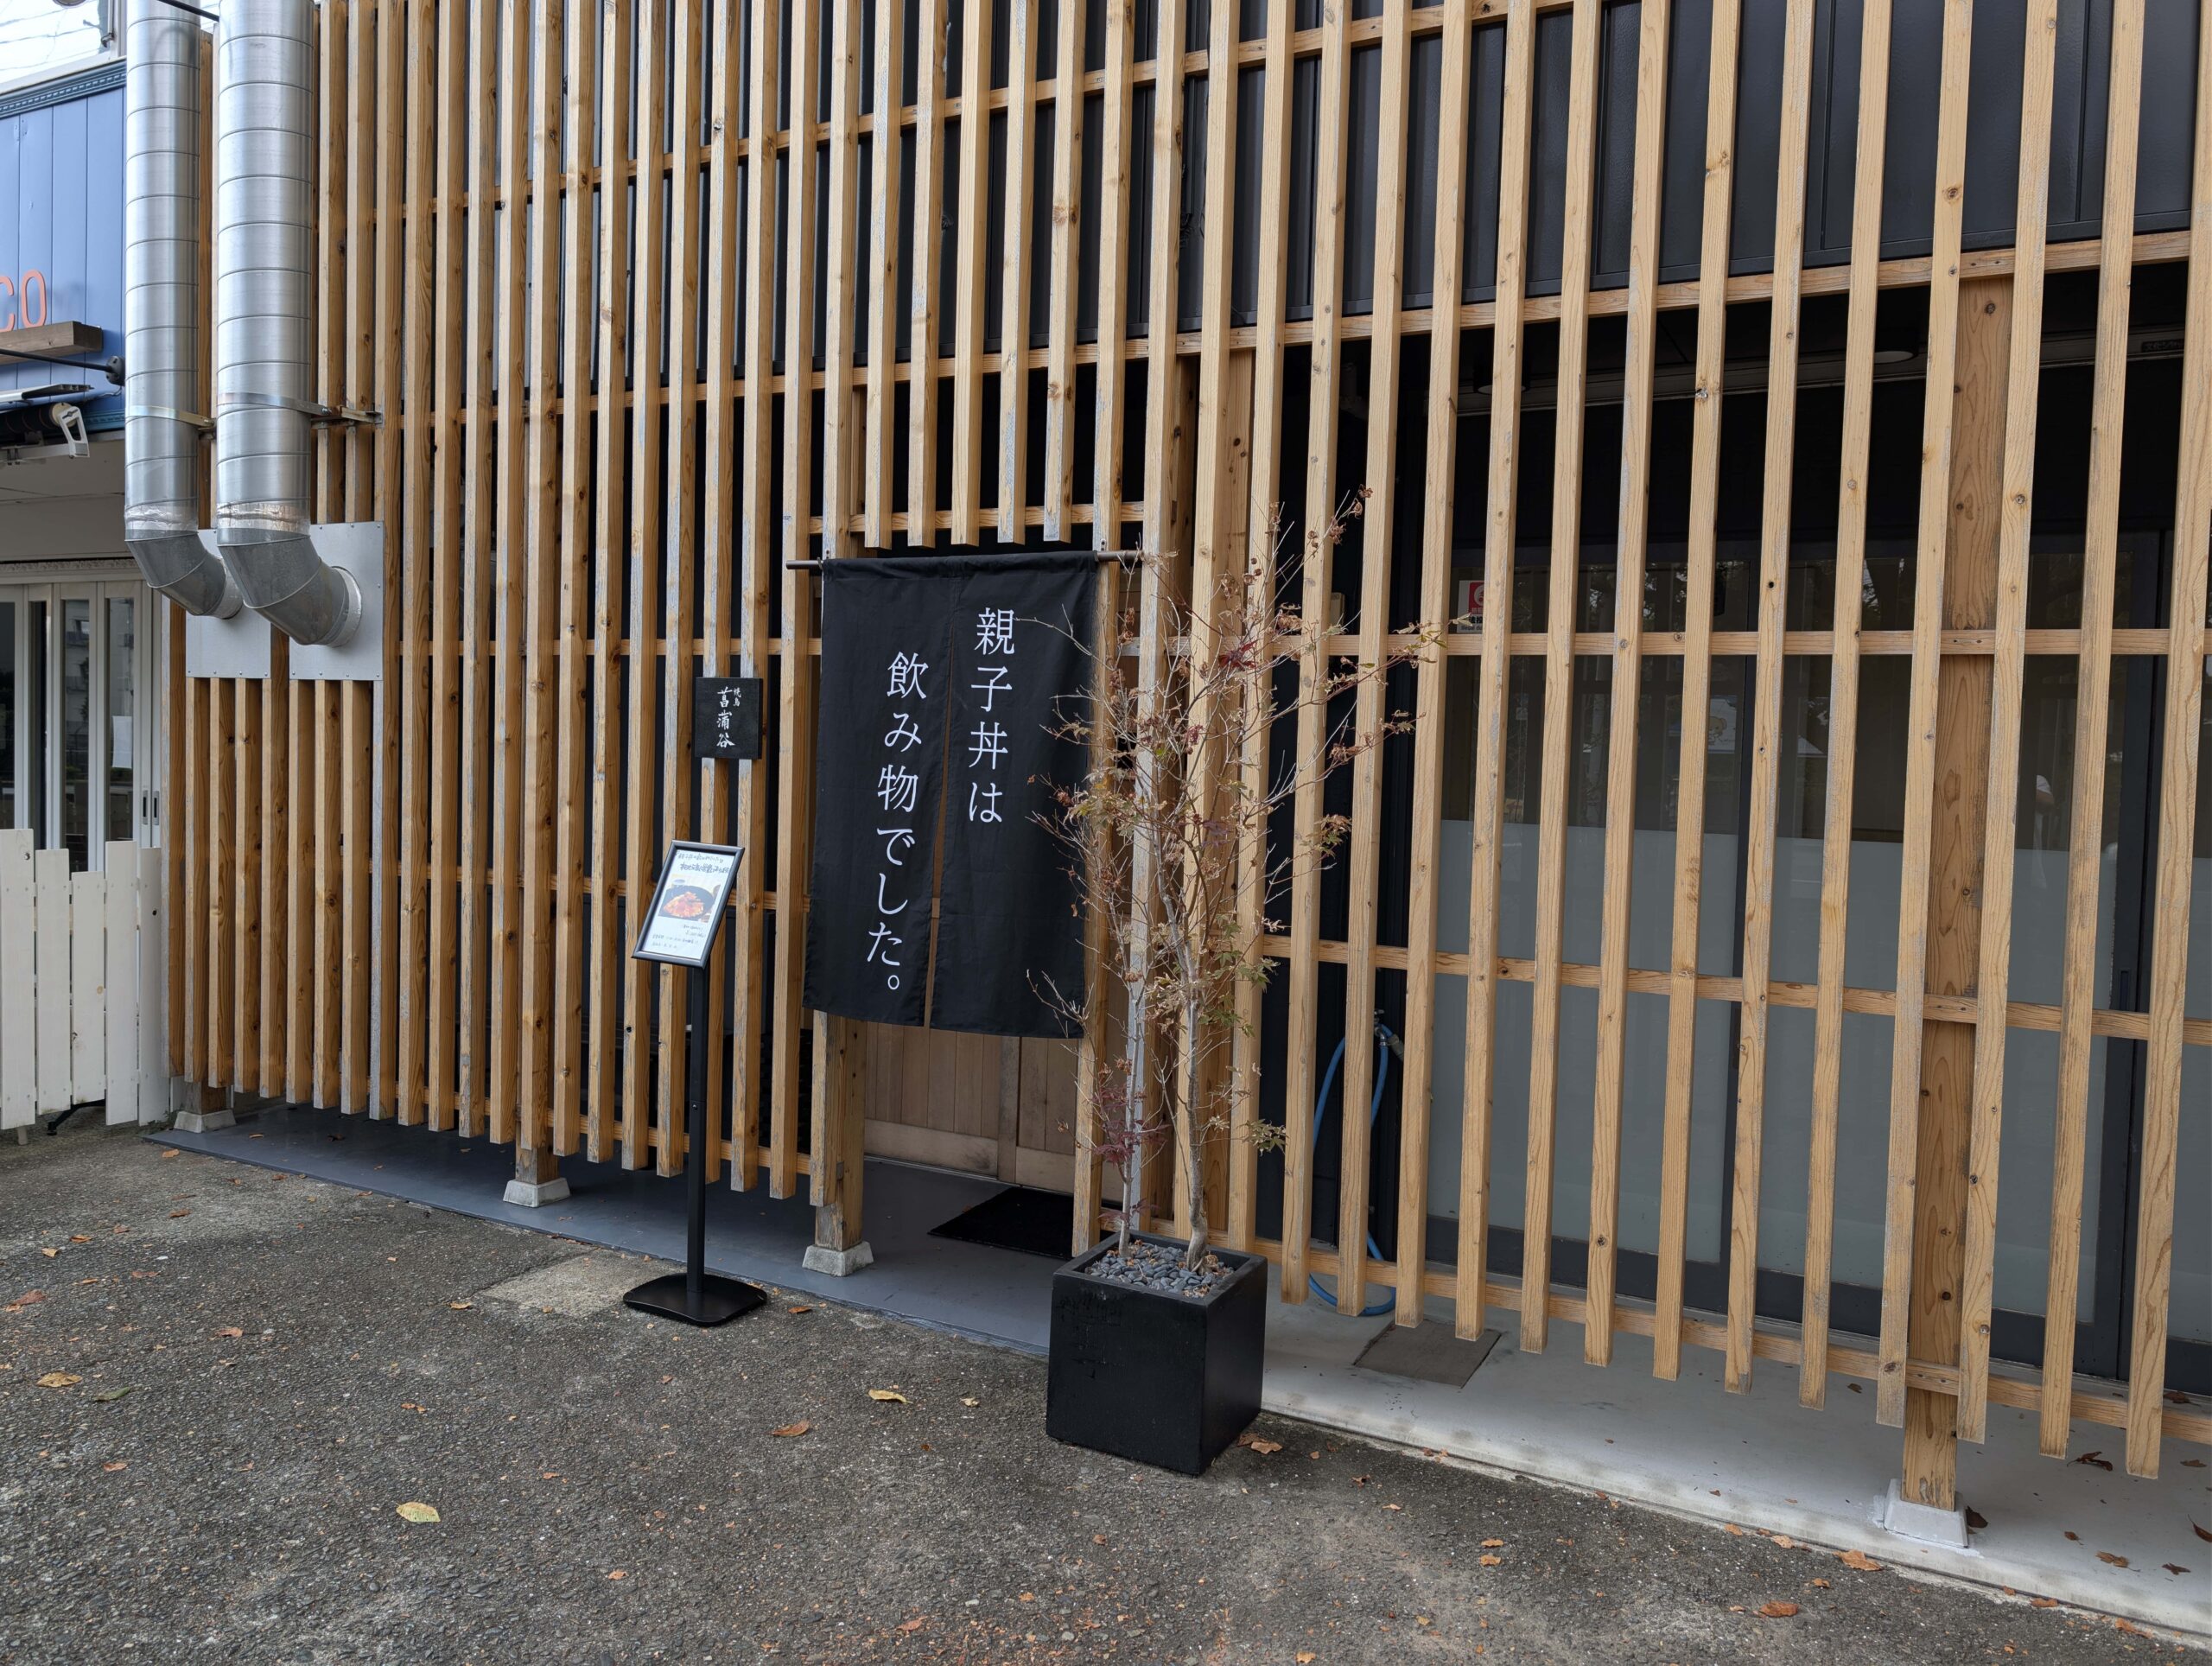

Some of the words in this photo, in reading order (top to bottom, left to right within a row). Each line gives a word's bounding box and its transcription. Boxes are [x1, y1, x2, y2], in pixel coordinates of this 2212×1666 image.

[716, 686, 736, 748] 菖蒲谷
[867, 651, 929, 990] 飲み物でした。
[968, 607, 1015, 823] 親子丼は
